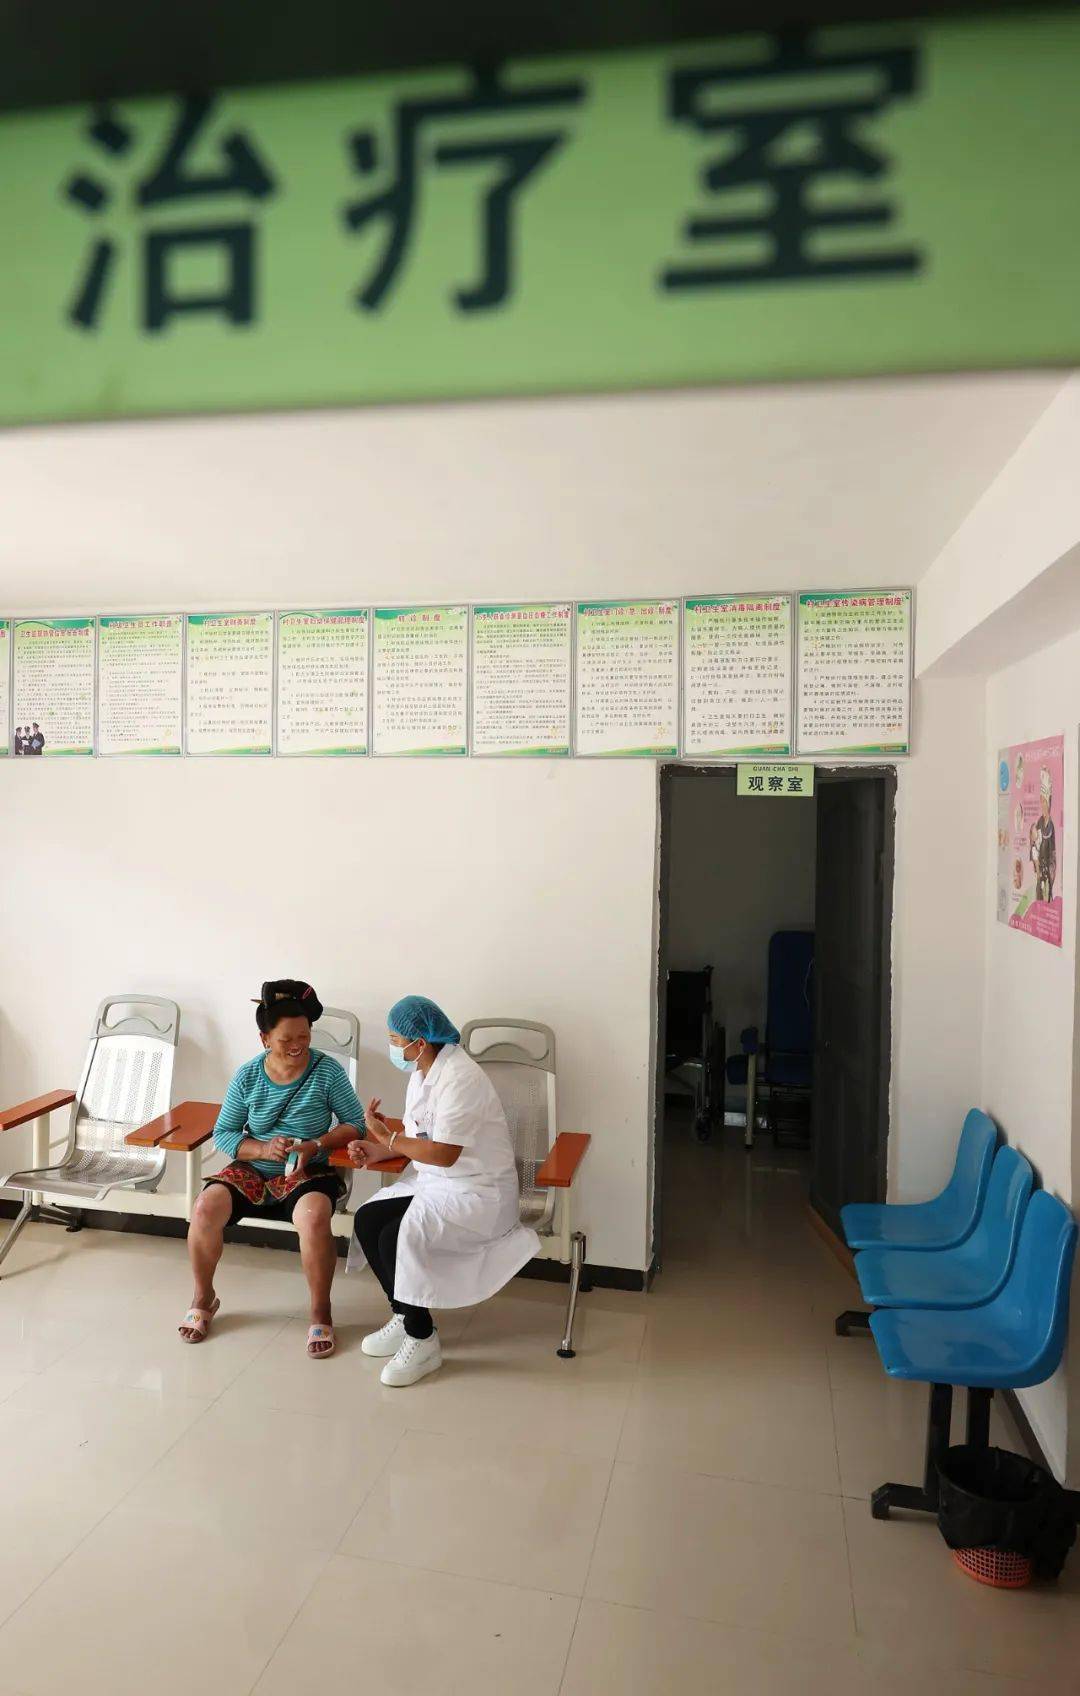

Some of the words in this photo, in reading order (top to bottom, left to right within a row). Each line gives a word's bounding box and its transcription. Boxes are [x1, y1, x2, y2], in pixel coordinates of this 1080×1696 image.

[60, 28, 926, 336] 治疗室
[694, 602, 781, 613] 村卫生室消毒隔离制度
[806, 597, 903, 609] 村卫生室传染病管理制度
[748, 775, 803, 792] 观察室
